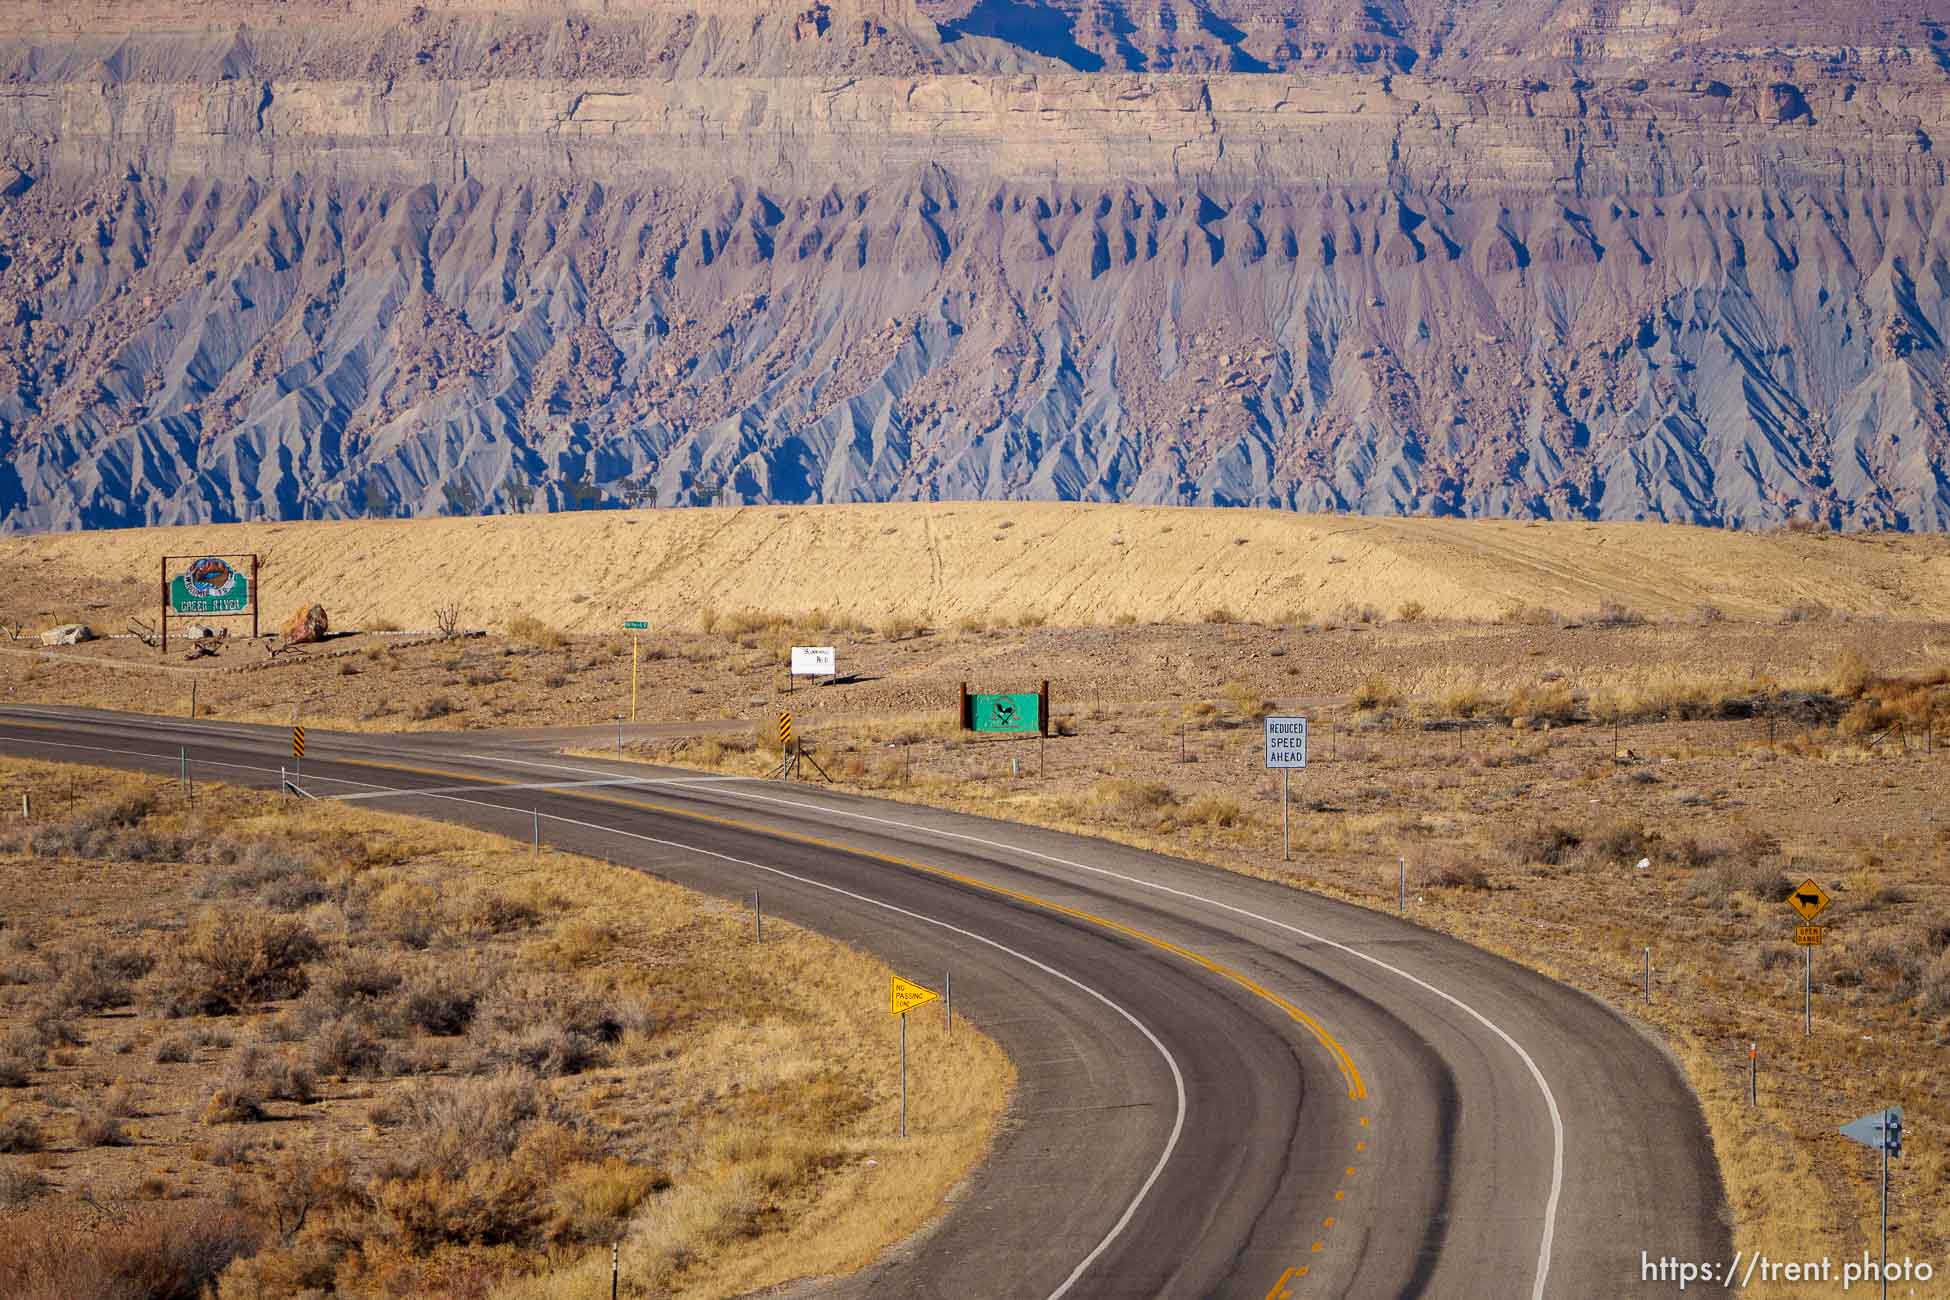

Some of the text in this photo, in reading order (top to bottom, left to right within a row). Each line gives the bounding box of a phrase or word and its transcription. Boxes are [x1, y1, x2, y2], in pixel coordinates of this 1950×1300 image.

[213, 599, 240, 611] RIVER
[1270, 723, 1303, 733] REDUCED
[1271, 738, 1302, 747] SPEED
[1270, 751, 1302, 761] AHEAD
